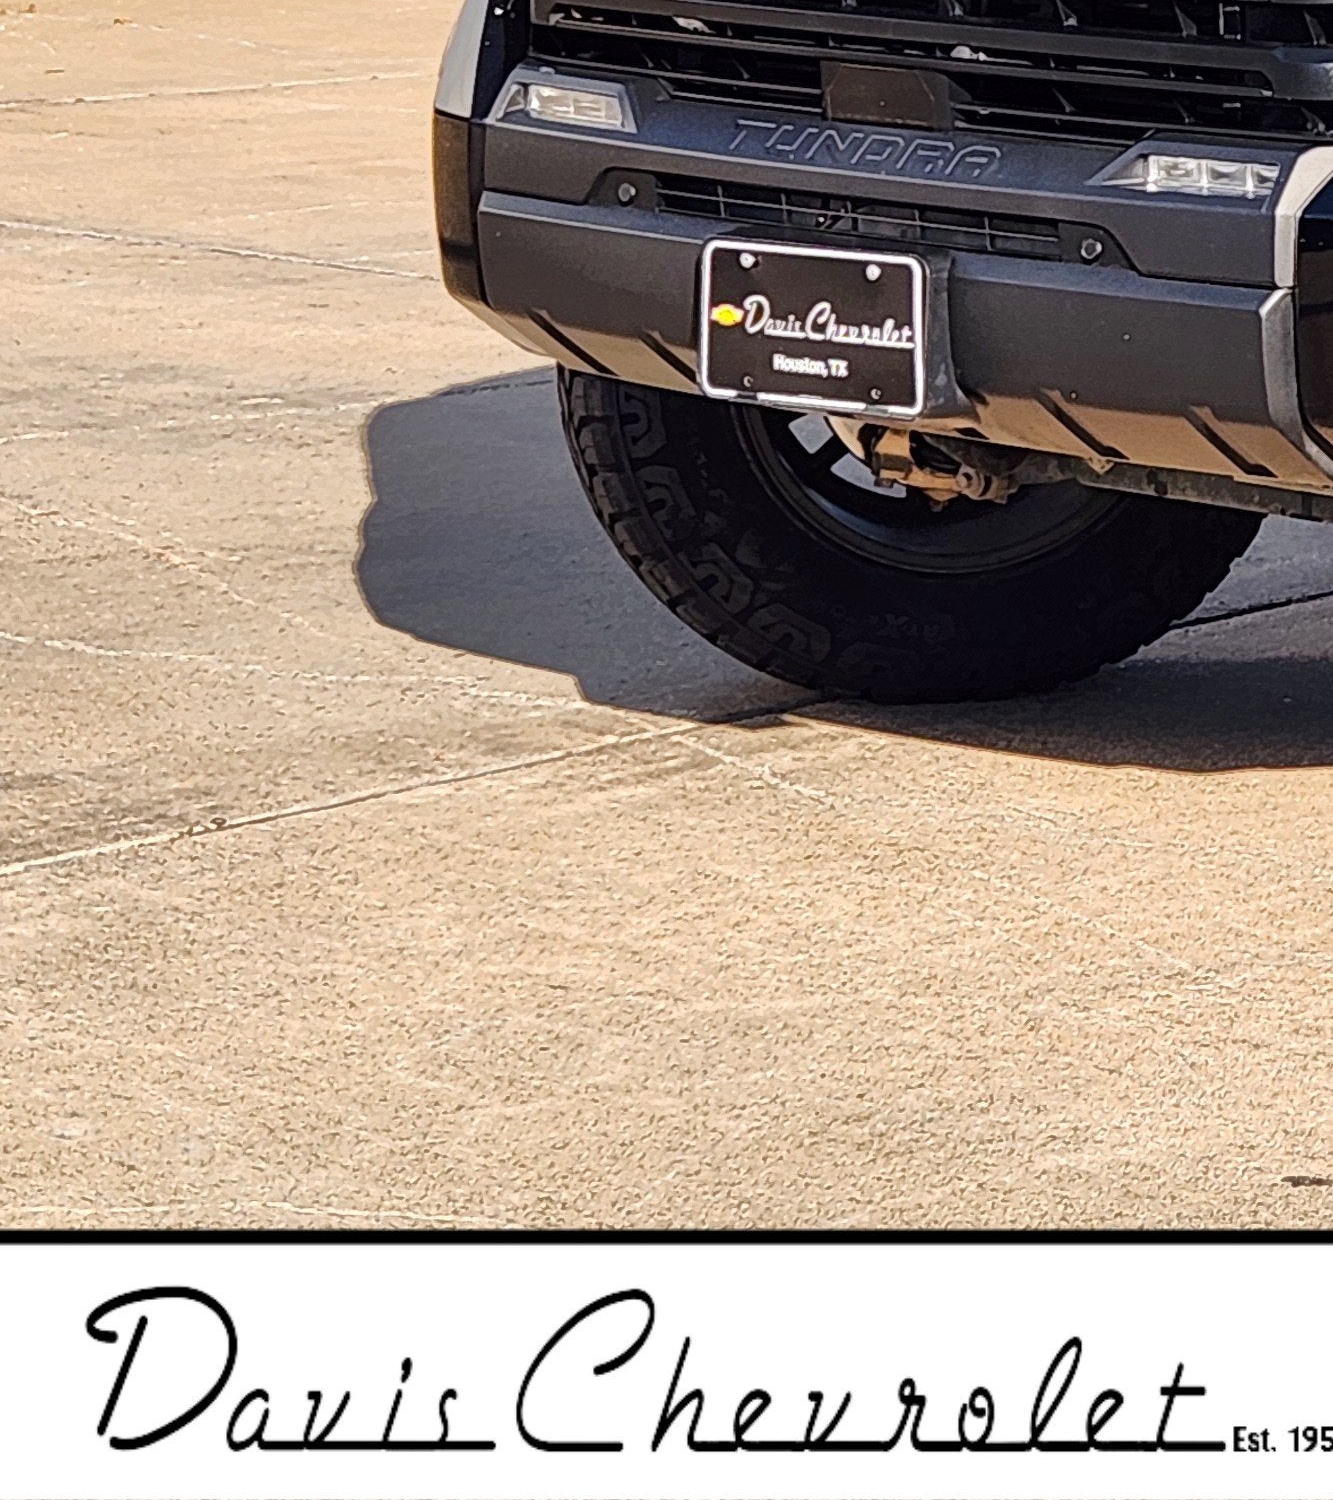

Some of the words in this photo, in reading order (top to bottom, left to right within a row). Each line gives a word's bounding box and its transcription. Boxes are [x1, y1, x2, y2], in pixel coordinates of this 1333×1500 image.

[729, 118, 1001, 178] TUNDRA
[743, 295, 806, 339] Davis
[804, 301, 915, 348] Chevrolet
[827, 358, 849, 377] TX
